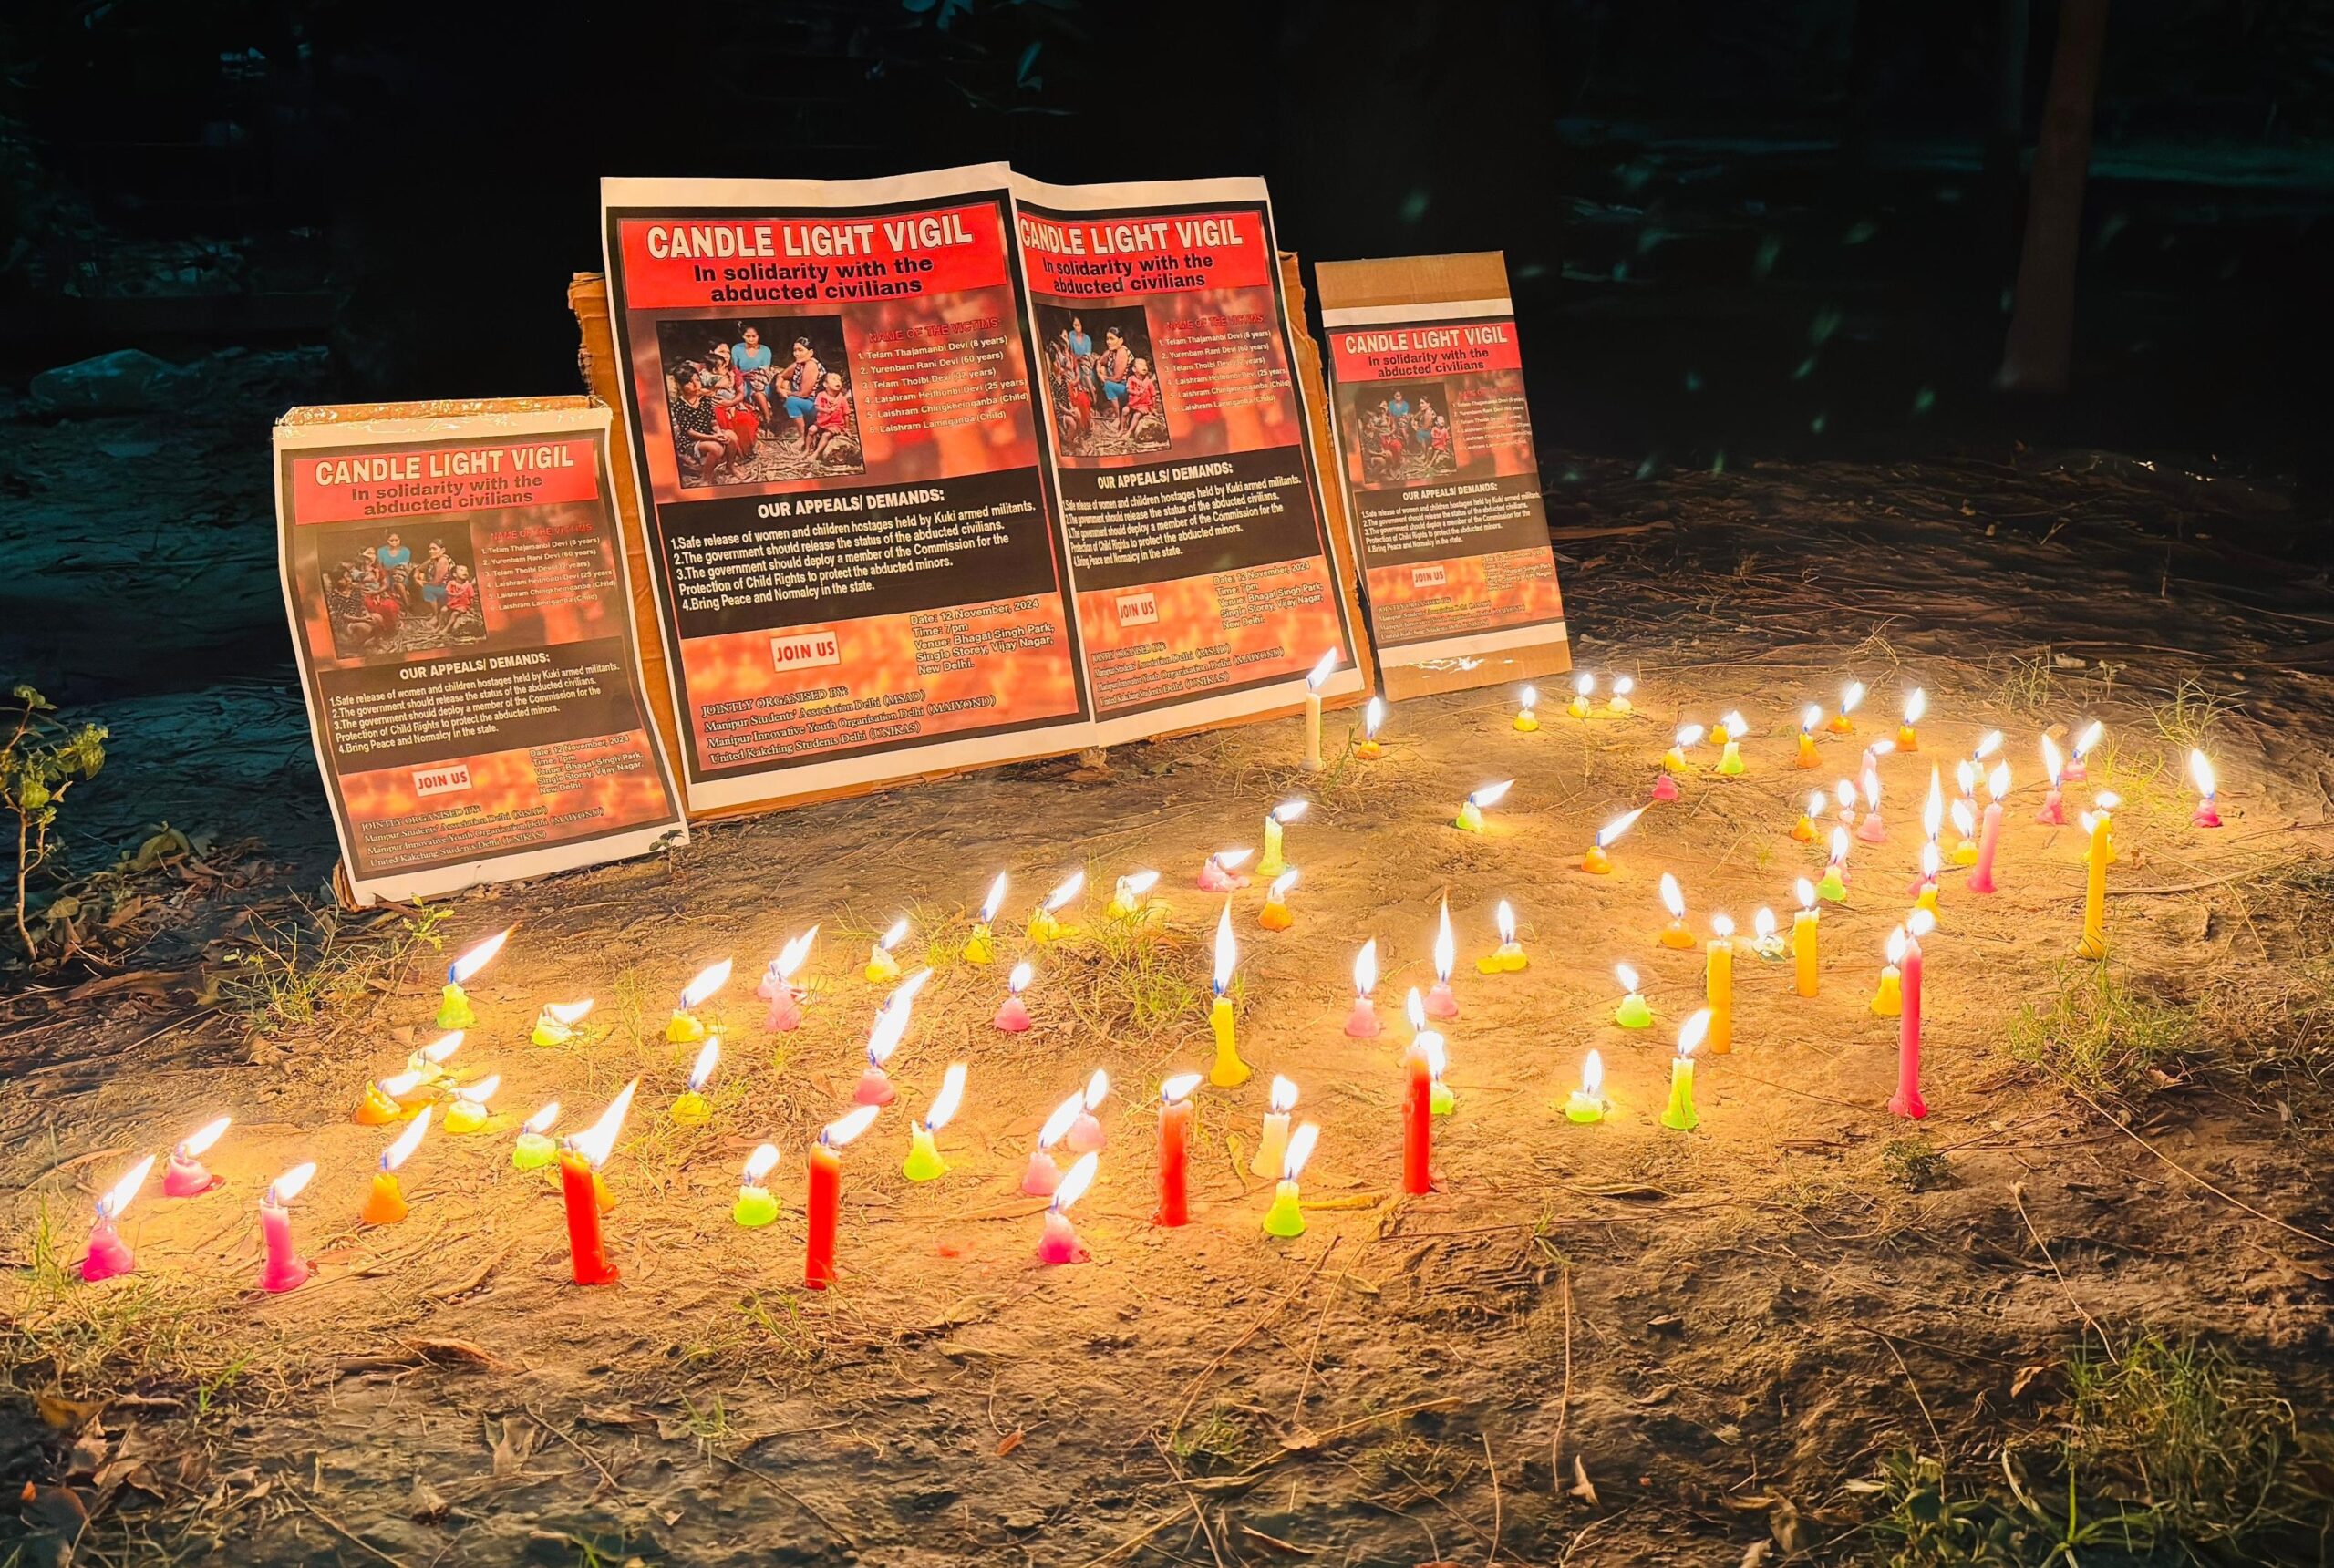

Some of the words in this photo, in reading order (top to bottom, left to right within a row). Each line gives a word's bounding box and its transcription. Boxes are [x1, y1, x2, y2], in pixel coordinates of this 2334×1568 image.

[646, 226, 775, 259] CANDLE
[783, 224, 874, 257] LIGHT
[883, 213, 974, 252] VIGIL
[1020, 218, 1086, 255] CANDLE
[1090, 223, 1168, 254] LIGHT
[1175, 219, 1244, 250] VIGIL
[694, 265, 716, 282] In
[724, 262, 828, 284] solidarity
[836, 259, 886, 277] with
[894, 257, 933, 273] the
[1043, 257, 1053, 273] In
[1057, 258, 1132, 277] solidarity
[1140, 255, 1179, 271] with
[1184, 253, 1213, 267] the
[711, 282, 818, 303] abducted
[825, 278, 923, 298] civilians
[1054, 277, 1124, 294] abducted
[1131, 273, 1205, 290] civilians
[869, 330, 904, 343] NAME
[907, 327, 922, 338] OF
[926, 324, 948, 336] THE
[951, 317, 1000, 334] VICTIMS:
[1346, 334, 1409, 354] CANDLE
[1414, 329, 1460, 350] LIGHT
[1464, 326, 1508, 346] VIGIL
[866, 350, 892, 359] Telam
[894, 345, 946, 357] Thajamanbi
[948, 341, 968, 350] Devi
[970, 339, 978, 349] (8
[980, 335, 1008, 348] years)
[1368, 356, 1379, 366] In
[1383, 352, 1438, 365] solidarity
[1441, 349, 1466, 360] with
[1470, 348, 1489, 357] the
[1379, 364, 1431, 377] abducted
[1437, 360, 1484, 372] civilians
[315, 457, 421, 486] CANDLE
[429, 449, 504, 478] LIGHT
[511, 445, 574, 471] VIGIL
[1098, 476, 1116, 489] OUR
[1118, 469, 1170, 488] APPEALS/
[1172, 462, 1233, 481] DEMANDS:
[352, 489, 368, 501] In
[377, 481, 463, 499] solidarity
[470, 478, 508, 491] with
[515, 475, 542, 488] the
[1403, 491, 1420, 500] OUR
[1421, 487, 1456, 499] APPEALS/
[1458, 482, 1498, 495] DEMANDS:
[364, 496, 451, 515] abducted
[459, 490, 532, 507] civilians
[758, 504, 791, 519] OUR
[795, 495, 862, 515] APPEALS/
[866, 488, 945, 509] DEMANDS:
[671, 536, 701, 549] 1.Safe
[704, 534, 739, 546] release
[742, 531, 752, 543] of
[754, 531, 790, 542] women
[792, 526, 810, 539] and
[812, 523, 850, 536] children
[852, 520, 893, 532] hostages
[895, 514, 916, 528] held
[920, 513, 932, 527] by
[934, 510, 955, 523] Kuki
[958, 506, 989, 521] armed
[992, 501, 1036, 516] militants.
[674, 552, 703, 564] 2.The
[706, 546, 764, 564] government
[767, 542, 800, 555] should
[802, 540, 835, 552] release
[837, 536, 852, 548] the
[854, 534, 882, 546] status
[884, 531, 893, 543] of
[895, 530, 911, 542] the
[914, 523, 959, 540] abducted
[962, 521, 1005, 534] civilians.
[676, 567, 706, 580] 3.The
[708, 561, 767, 580] government
[769, 555, 802, 570] should
[804, 553, 834, 568] deploy
[838, 554, 843, 562] a
[845, 548, 882, 562] member
[884, 545, 893, 557] of
[895, 544, 911, 556] the
[914, 537, 975, 553] Commission
[977, 535, 990, 546] for
[993, 532, 1009, 544] the
[679, 580, 731, 595] Protection
[734, 577, 744, 589] of
[746, 574, 772, 588] Child
[774, 572, 806, 587] Rights
[808, 571, 817, 581] to
[820, 566, 852, 583] protect
[853, 564, 868, 576] the
[871, 559, 914, 574] abducted
[915, 557, 953, 569] minors.
[1415, 572, 1432, 583] JOIN
[1434, 571, 1444, 580] US
[683, 597, 719, 611] 4.Bring
[722, 594, 751, 606] Peace
[754, 590, 772, 603] and
[775, 585, 819, 600] Normalcy
[822, 583, 831, 594] in
[832, 582, 847, 593] the
[850, 580, 874, 592] state.
[910, 615, 937, 624] Date:
[942, 612, 953, 621] 12
[955, 604, 1012, 619] November,
[1015, 599, 1038, 610] 2024
[1121, 603, 1138, 618] JOIN
[1141, 601, 1153, 615] US
[913, 626, 942, 637] Time:
[945, 624, 968, 634] 7pm
[915, 639, 951, 650] Venue:
[955, 631, 992, 645] Bhagat
[994, 626, 1024, 639] Singh
[1028, 623, 1055, 633] Park,
[777, 644, 811, 662] JOIN
[817, 641, 835, 656] US
[916, 650, 950, 662] Single
[953, 645, 988, 656] Storey,
[991, 640, 1017, 652] Vijay
[1019, 636, 1053, 648] Nagar,
[400, 667, 427, 680] OUR
[431, 659, 487, 676] APPEALS/
[490, 653, 550, 669] DEMANDS:
[918, 664, 940, 675] New
[944, 659, 974, 671] Delhi.
[701, 699, 754, 717] JOINTLY
[756, 689, 827, 708] ORGANISED
[830, 686, 849, 698] BY:
[705, 717, 749, 732] Manipur
[750, 710, 796, 725] Students'
[799, 704, 852, 717] Association
[855, 697, 881, 709] Delhi
[883, 689, 925, 707] (MSAD)
[707, 734, 750, 748] Manipur
[753, 726, 805, 742] Innovative
[807, 719, 836, 733] Youth
[839, 713, 898, 728] Organisation
[899, 707, 924, 718] Delhi
[927, 695, 996, 716] (MAIYOND)
[710, 750, 744, 764] United
[746, 744, 793, 758] Kakching
[796, 736, 838, 751] Students
[841, 731, 866, 744] Delhi
[869, 721, 921, 740] (UNIKAS)
[418, 775, 447, 789] JOIN
[453, 771, 468, 783] US
